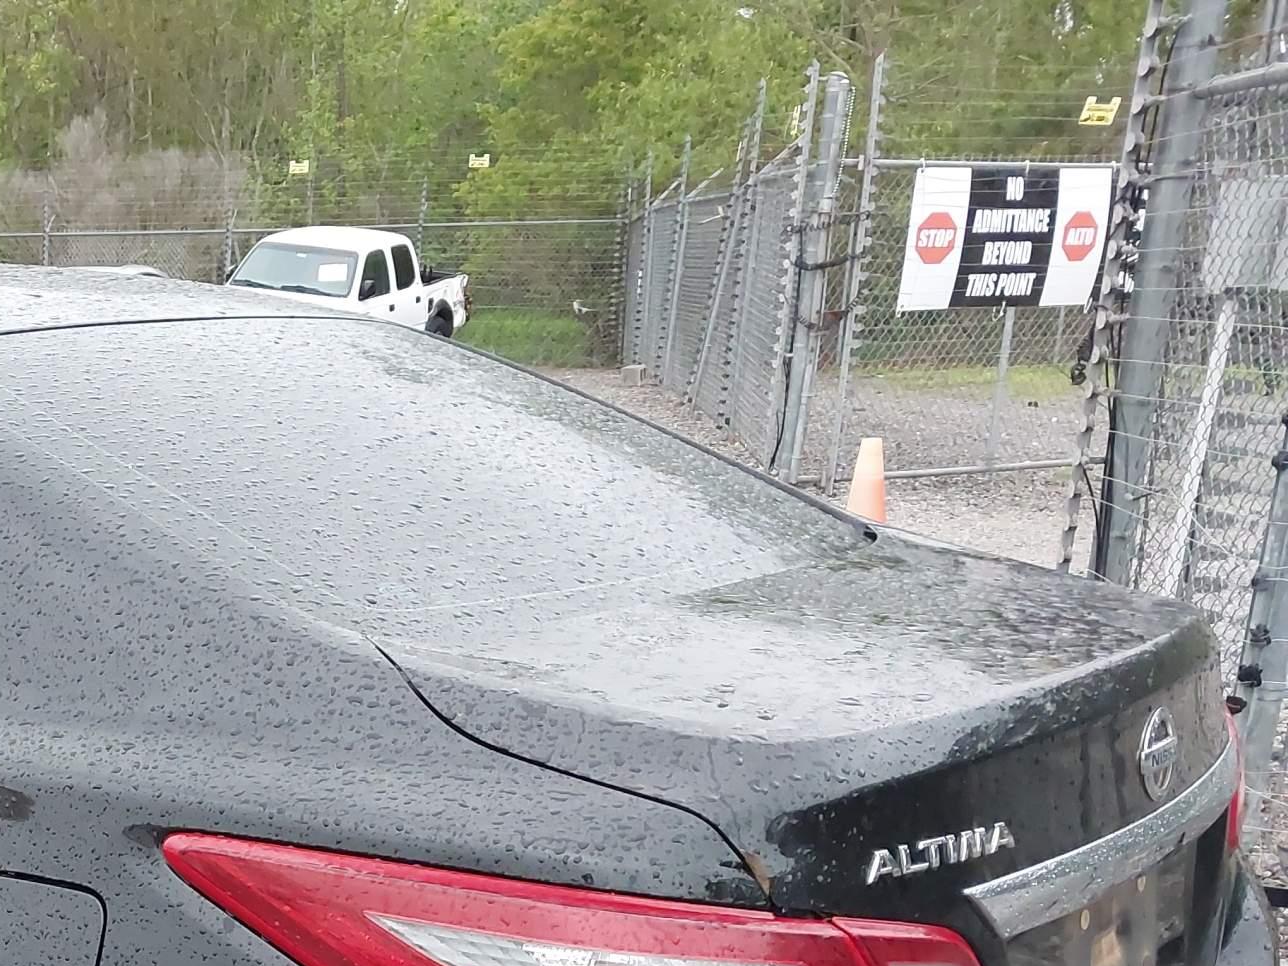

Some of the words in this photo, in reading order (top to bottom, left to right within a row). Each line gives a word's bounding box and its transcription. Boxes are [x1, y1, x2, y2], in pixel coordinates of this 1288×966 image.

[1006, 176, 1025, 201] NO
[972, 208, 1052, 234] ADMITTANCE
[917, 228, 955, 248] STOP
[1064, 226, 1096, 246] ALTO
[981, 240, 1033, 265] BEYOND
[965, 273, 997, 297] THIS
[995, 272, 1037, 297] POINT
[866, 821, 1016, 886] ALTIMA
